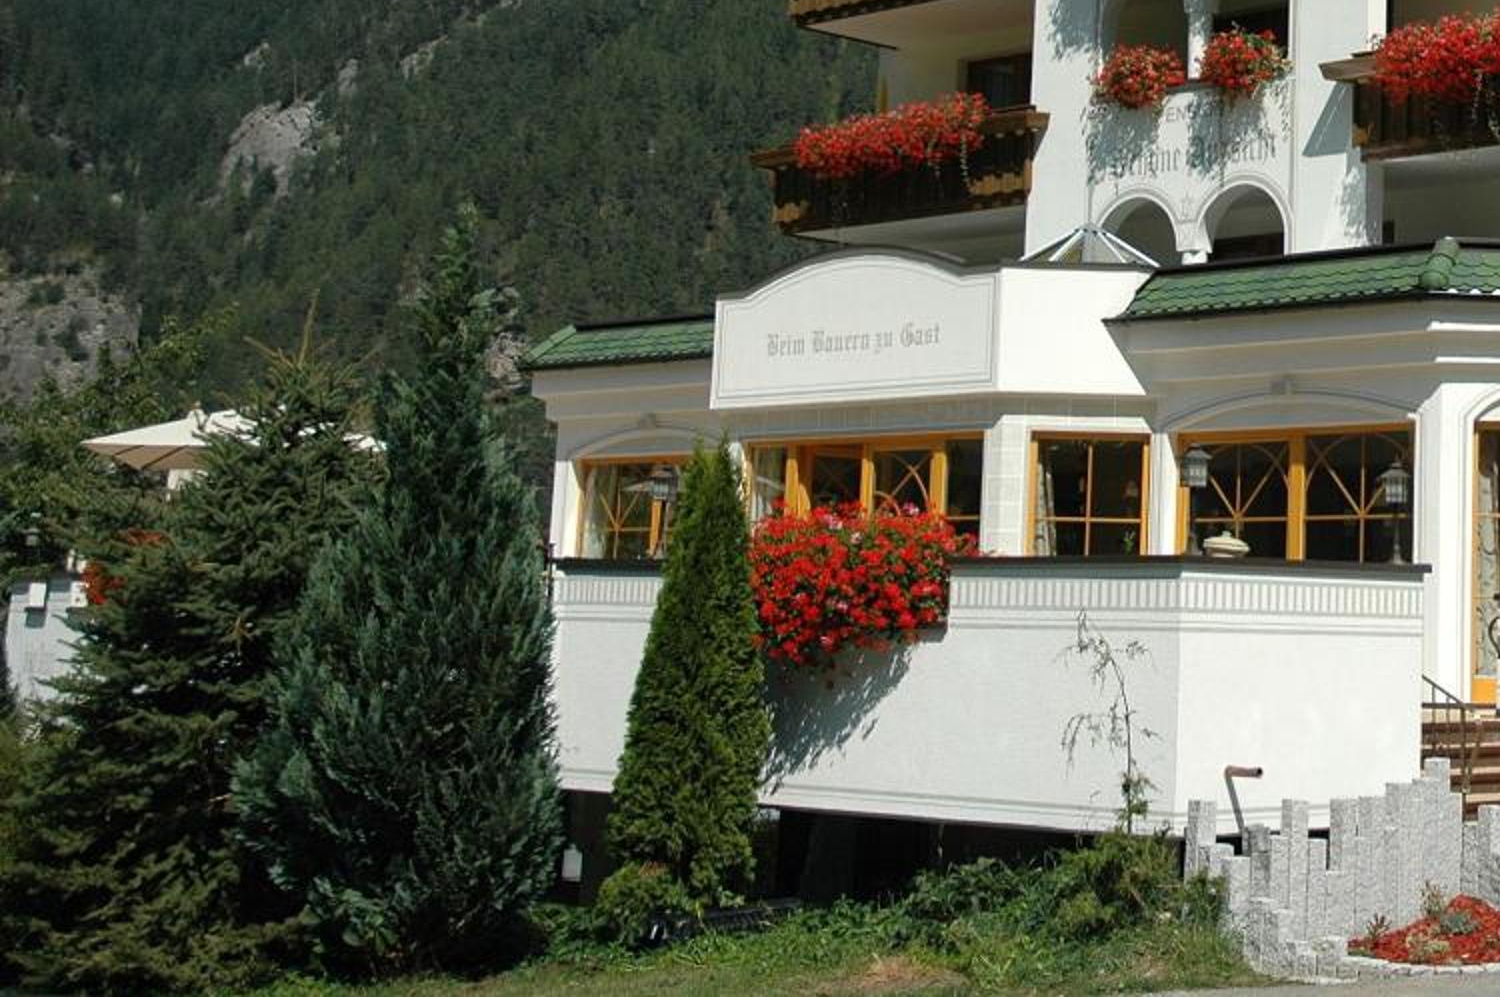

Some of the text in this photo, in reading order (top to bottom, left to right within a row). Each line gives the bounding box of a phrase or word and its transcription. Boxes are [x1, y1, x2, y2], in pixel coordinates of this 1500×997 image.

[767, 321, 941, 356] Beim Bauern zu Gast
